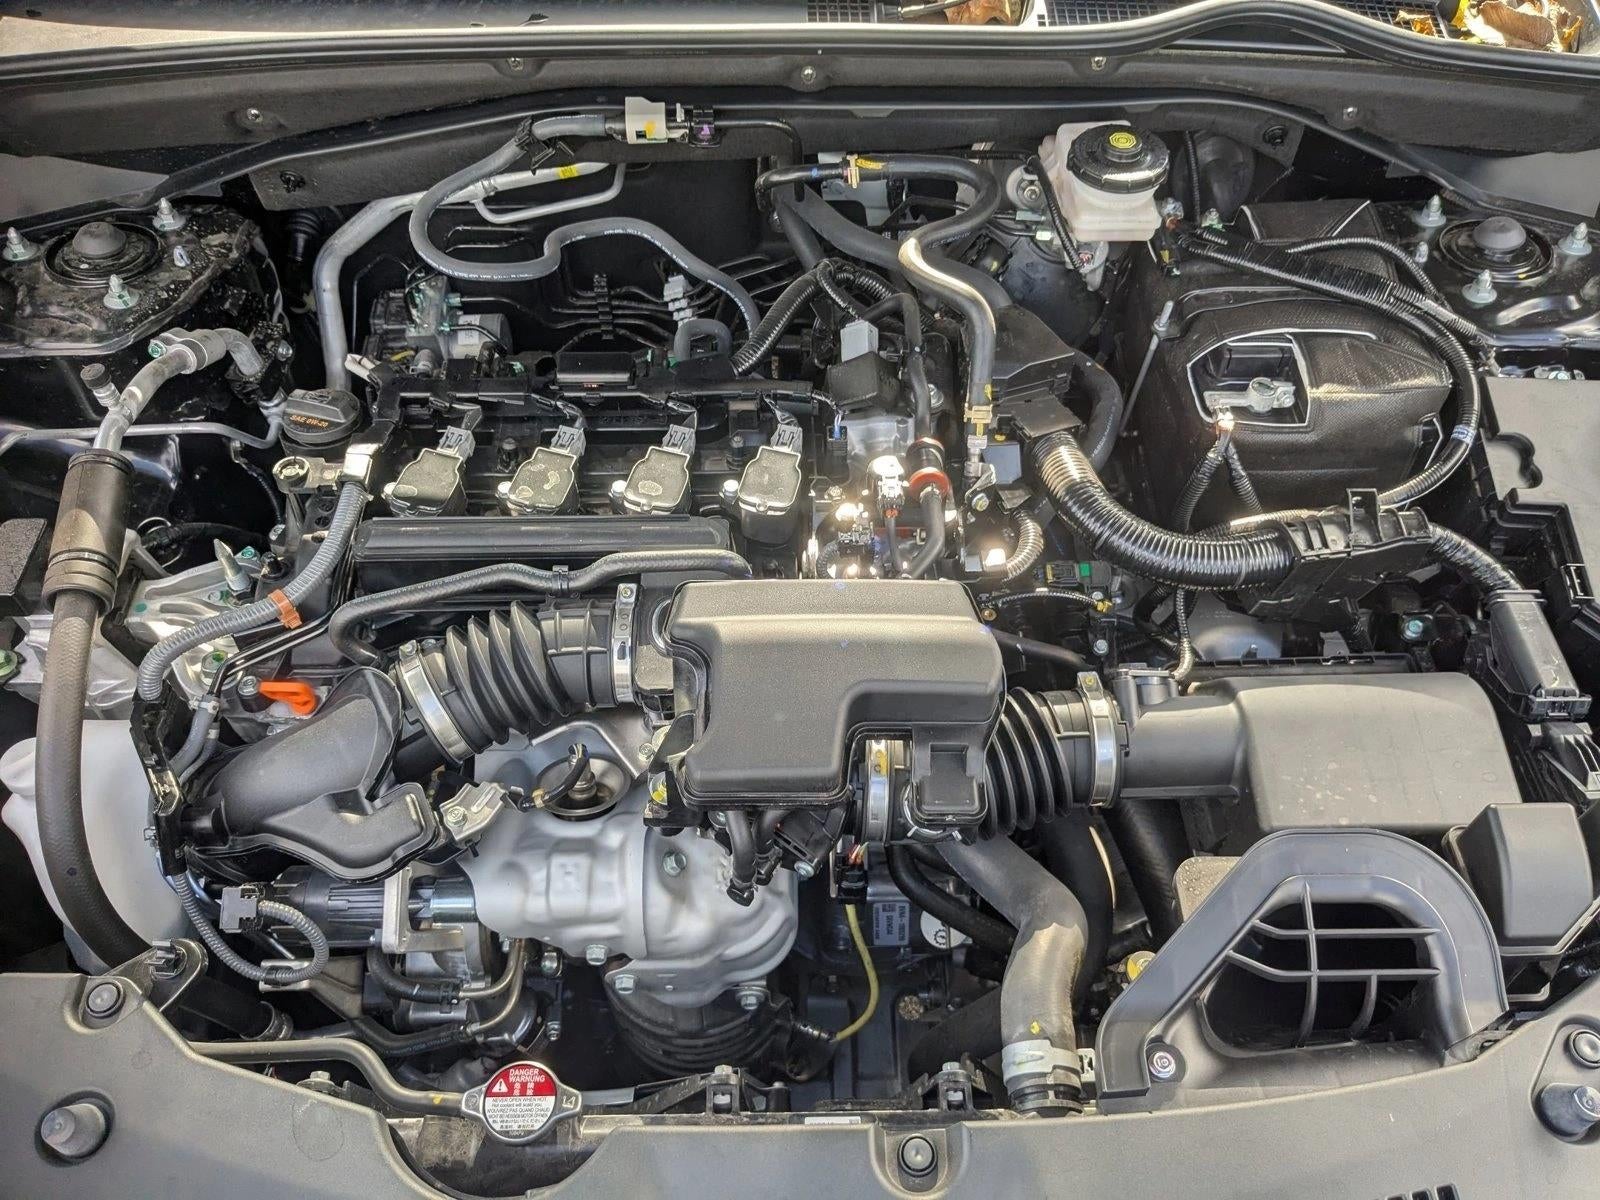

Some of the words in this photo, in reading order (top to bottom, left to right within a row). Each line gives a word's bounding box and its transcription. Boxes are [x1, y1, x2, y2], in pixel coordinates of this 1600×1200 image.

[289, 415, 307, 423] SAE
[306, 418, 329, 428] 0W-20
[509, 1068, 540, 1076] DANGER
[509, 1075, 546, 1083] WARNUNG
